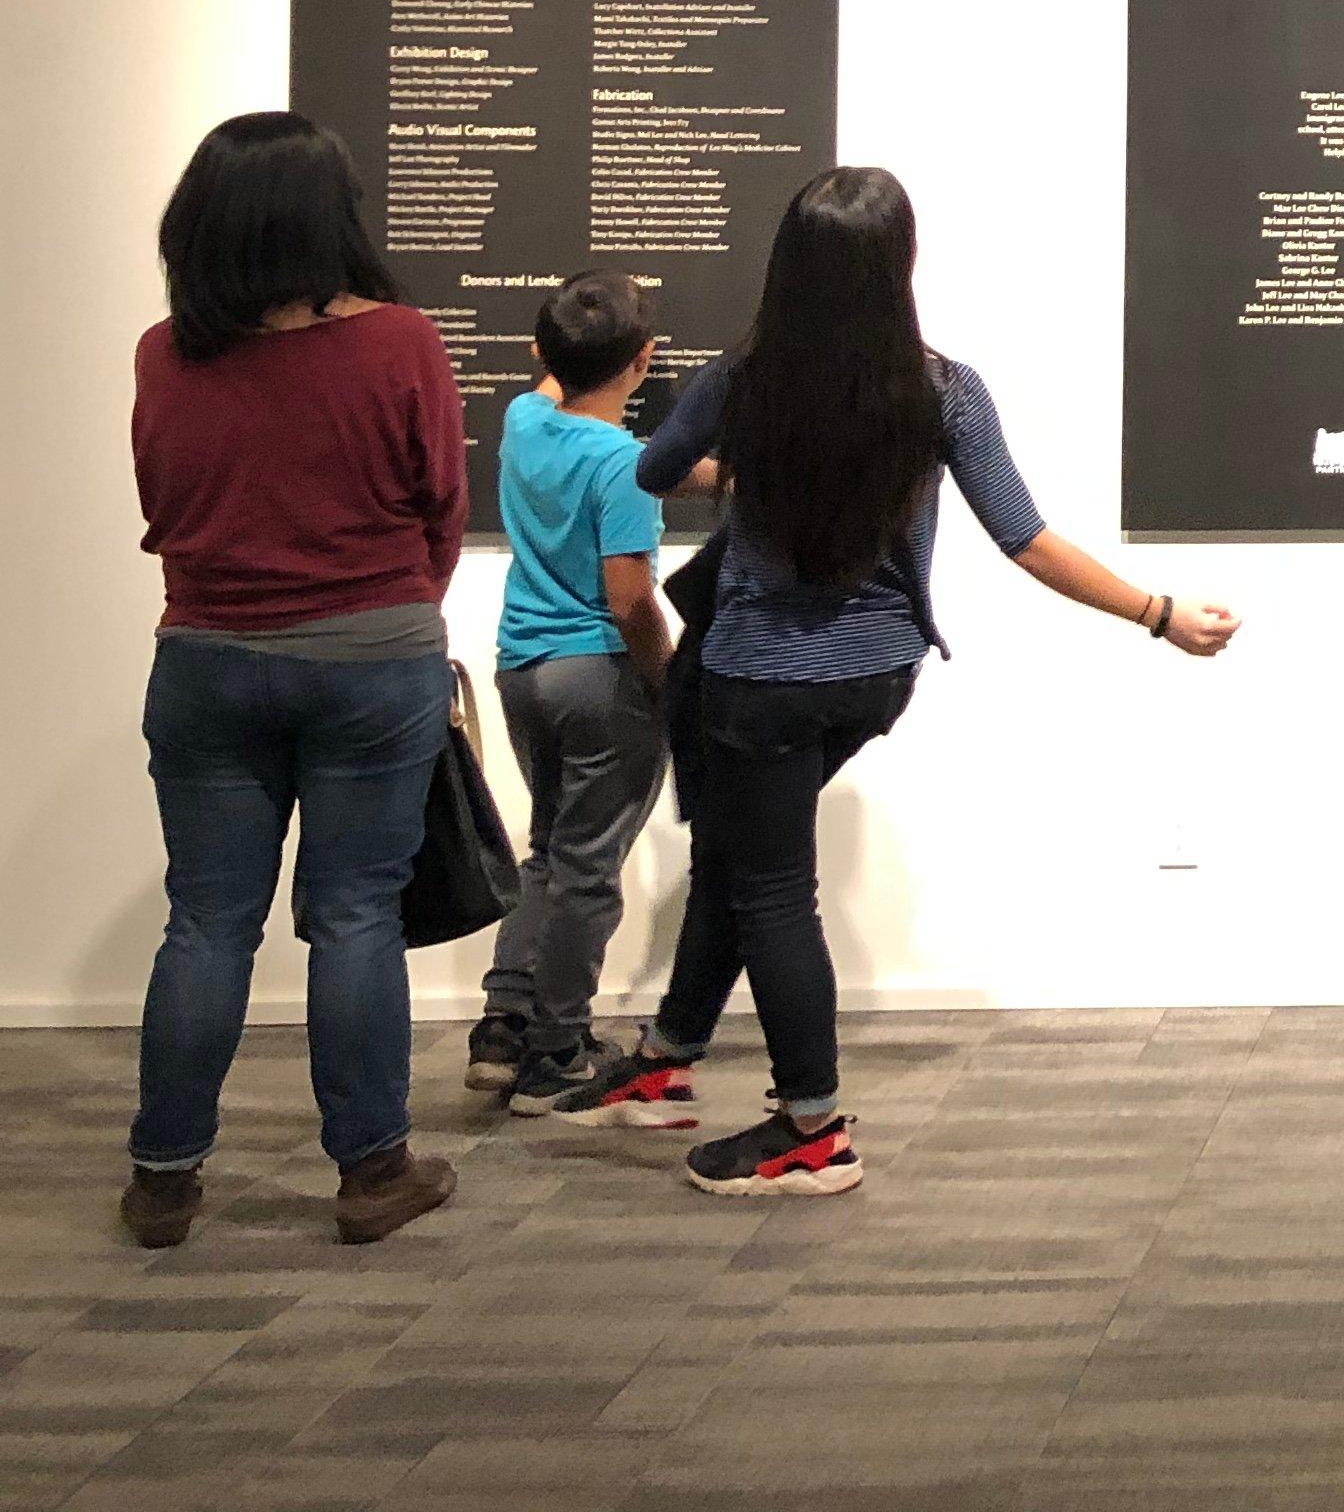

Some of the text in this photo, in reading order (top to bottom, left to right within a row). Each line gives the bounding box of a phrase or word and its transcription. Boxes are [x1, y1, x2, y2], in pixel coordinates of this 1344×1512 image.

[390, 46, 488, 60] Exhibition Design
[593, 88, 653, 101] Fabrication
[388, 123, 536, 138] Audio Visual Components
[461, 274, 502, 287] Donors
[504, 274, 525, 287] and
[528, 274, 565, 287] Lender
